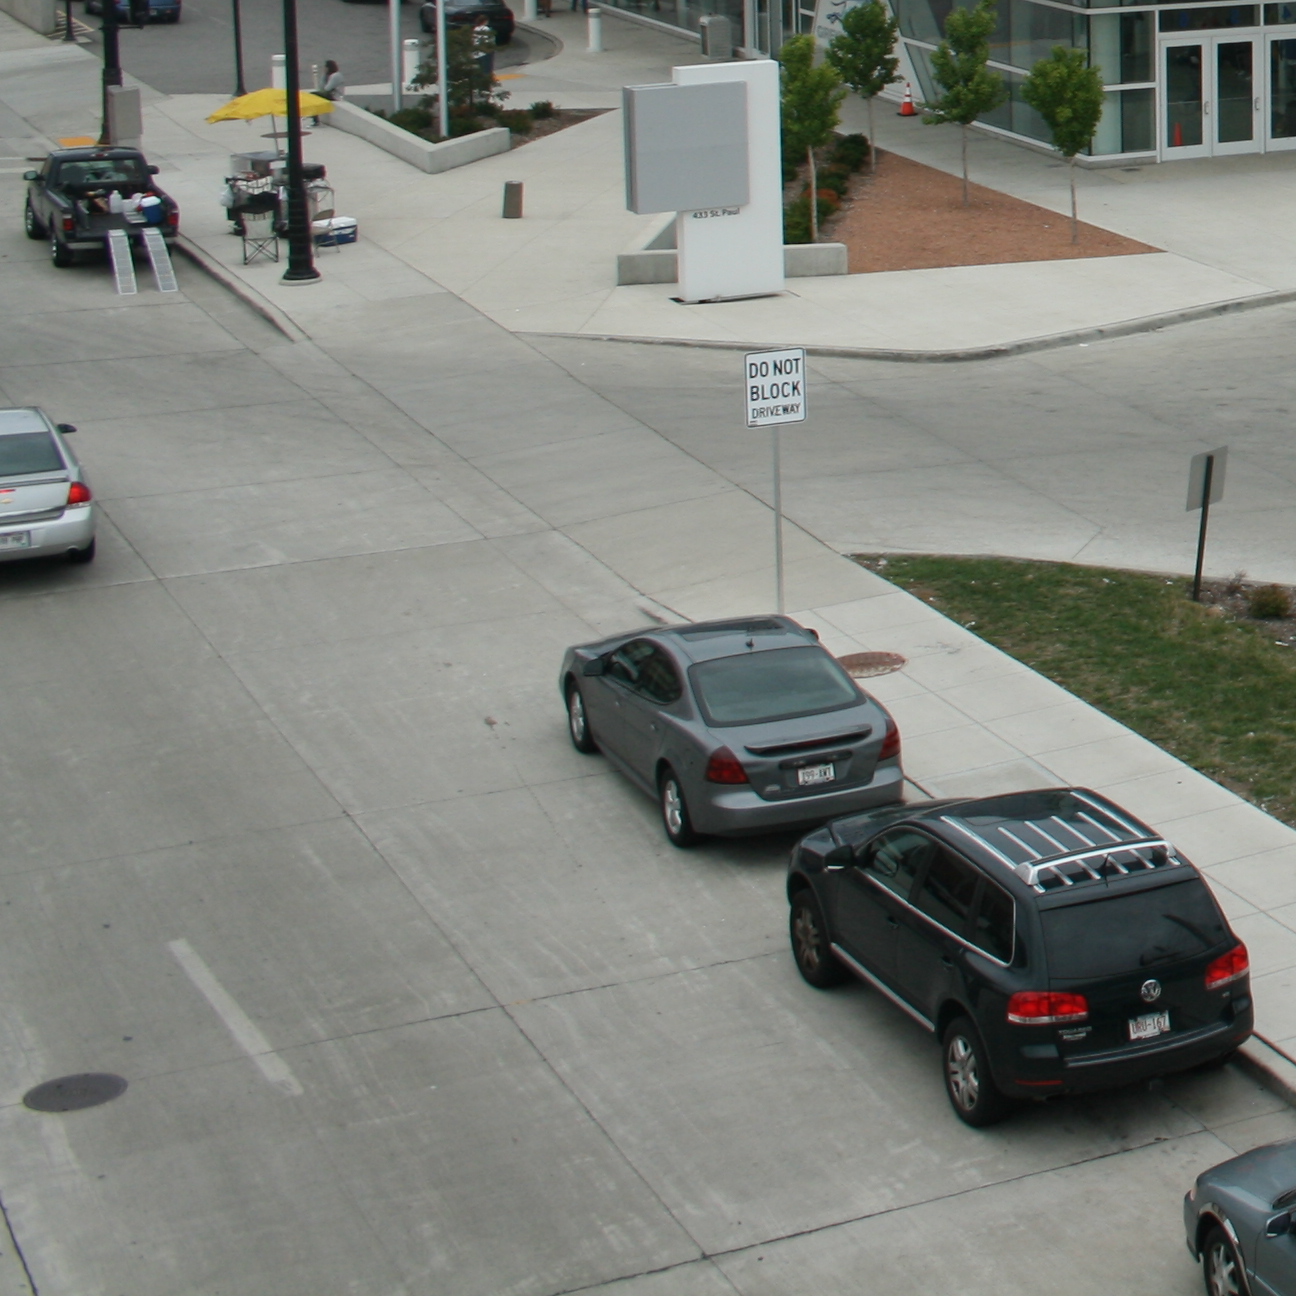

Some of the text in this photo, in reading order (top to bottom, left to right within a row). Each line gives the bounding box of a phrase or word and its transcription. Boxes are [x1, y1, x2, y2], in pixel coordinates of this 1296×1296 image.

[722, 207, 740, 216] Paul
[749, 358, 801, 379] DO NOT
[750, 380, 801, 401] BLOCK
[752, 402, 801, 419] DRIVEWAY
